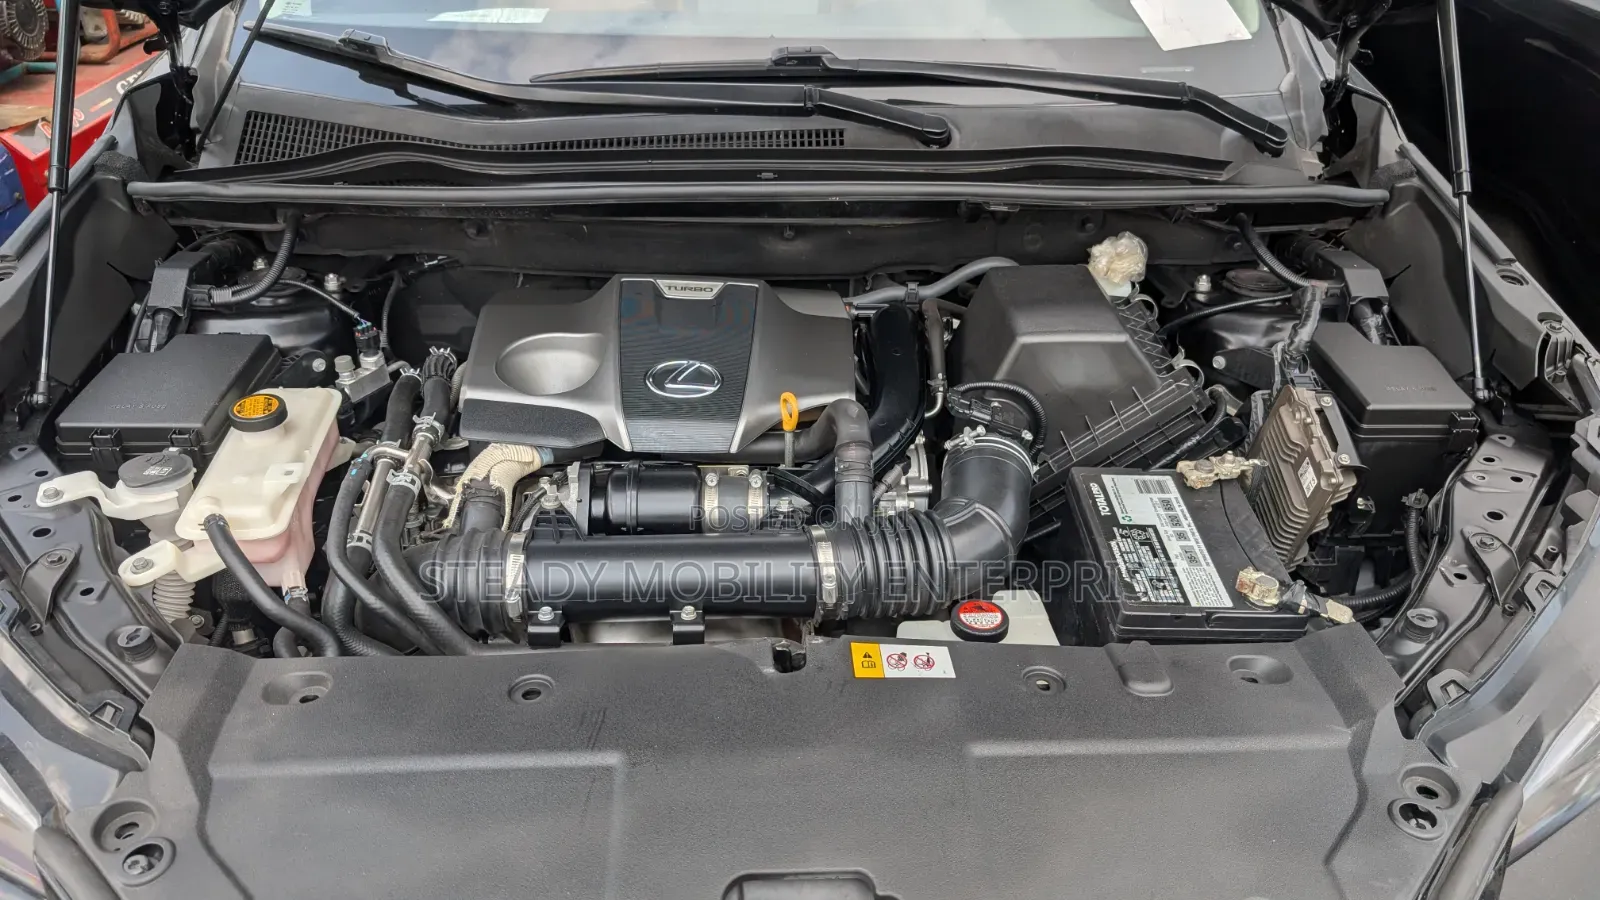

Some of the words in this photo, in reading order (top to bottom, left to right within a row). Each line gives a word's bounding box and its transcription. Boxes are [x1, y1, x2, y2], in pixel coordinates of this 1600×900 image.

[1089, 482, 1112, 516] TOTALPRO
[1168, 515, 1182, 527] 520
[1176, 532, 1187, 540] 35
[1184, 549, 1198, 564] 35-T
